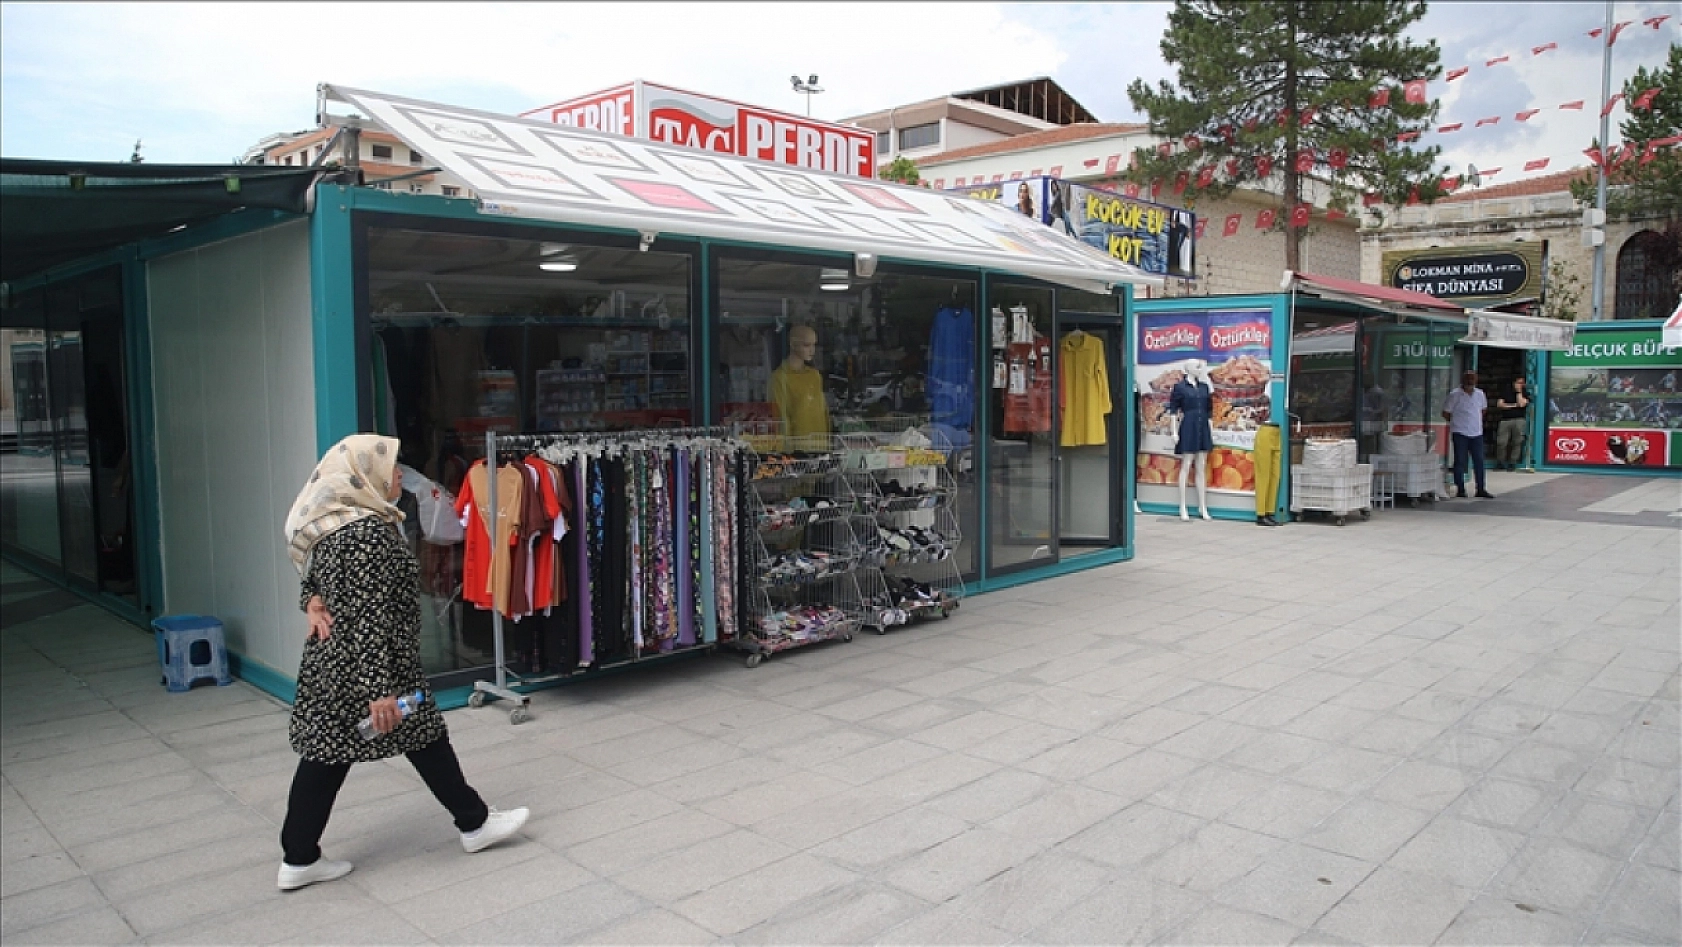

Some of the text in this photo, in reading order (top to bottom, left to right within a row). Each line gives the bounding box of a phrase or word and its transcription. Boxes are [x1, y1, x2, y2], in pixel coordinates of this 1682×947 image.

[557, 95, 631, 134] RDE
[746, 115, 869, 177] PERDE
[1147, 209, 1165, 235] EV
[1108, 234, 1143, 265] KOT
[1412, 265, 1460, 277] LOKMAN
[1463, 262, 1493, 275] MİNA
[1438, 279, 1504, 294] DÜNYASI
[1144, 328, 1200, 350] Öztürkler
[1210, 326, 1269, 348] Öztürkler
